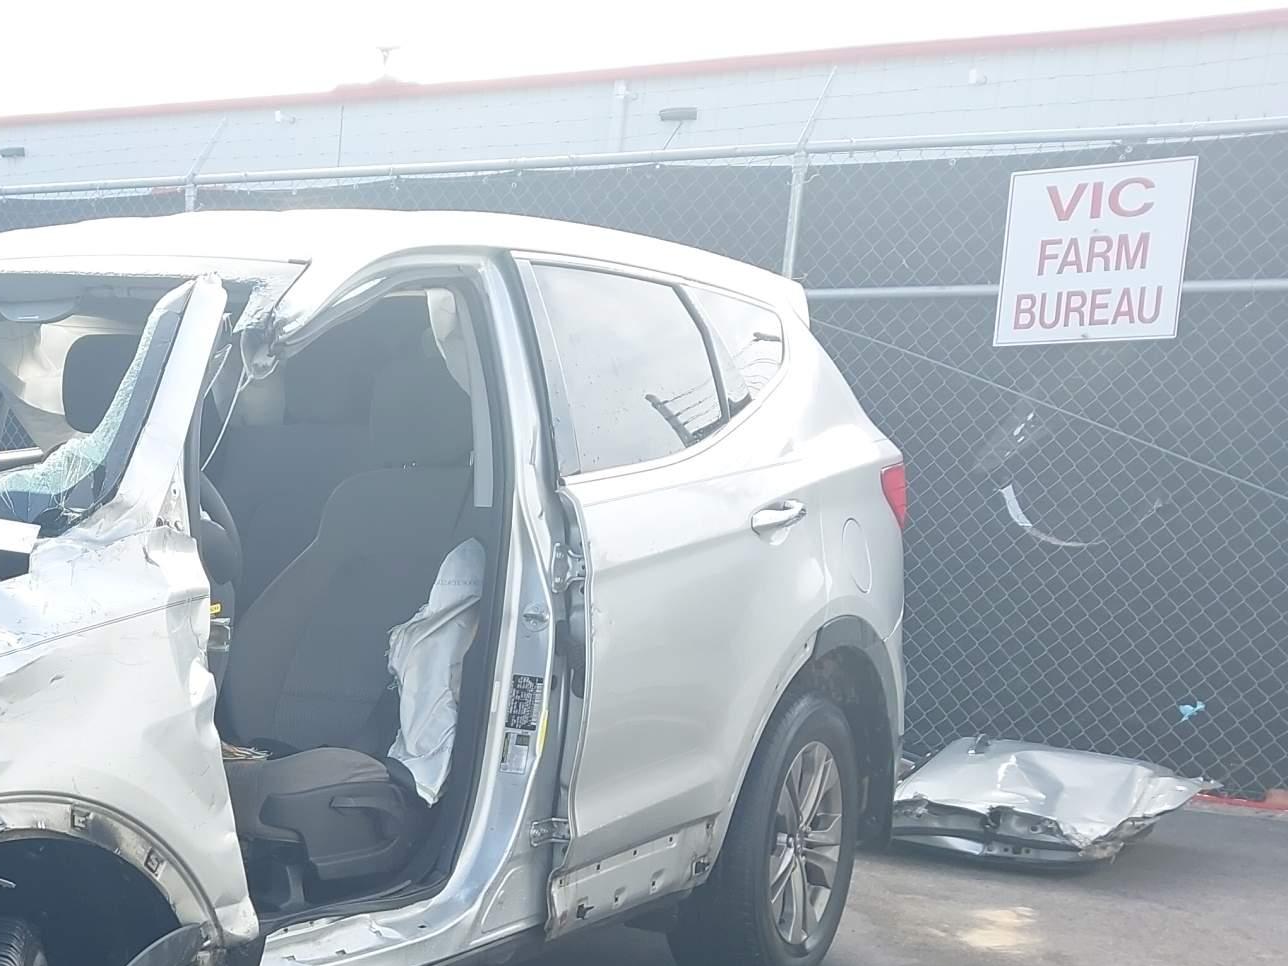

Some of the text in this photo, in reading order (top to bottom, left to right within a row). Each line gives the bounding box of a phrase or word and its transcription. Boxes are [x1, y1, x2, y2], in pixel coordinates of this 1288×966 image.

[1046, 177, 1156, 222] VIC
[1037, 232, 1151, 276] FARM
[1012, 285, 1164, 331] BUREAU
